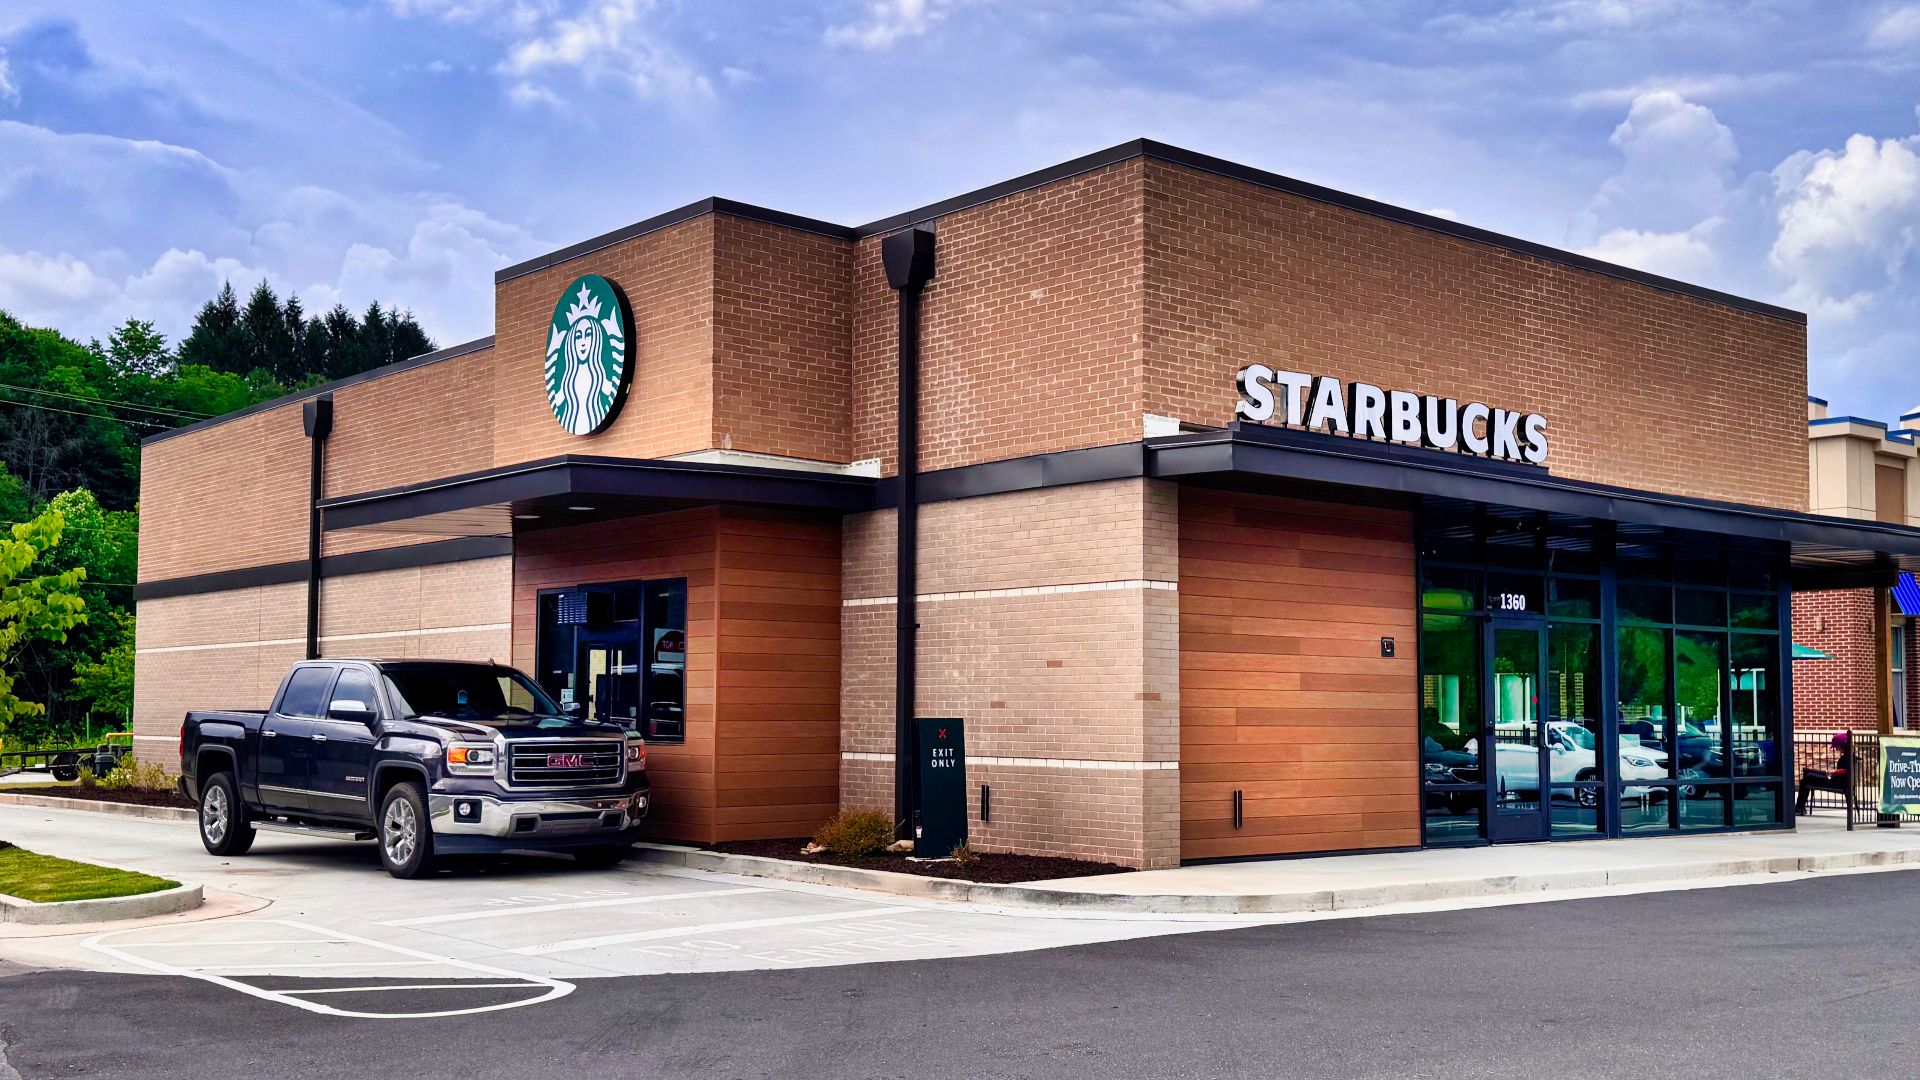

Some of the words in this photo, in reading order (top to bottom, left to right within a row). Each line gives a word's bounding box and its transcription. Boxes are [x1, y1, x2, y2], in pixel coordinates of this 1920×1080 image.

[1236, 363, 1548, 464] STARBUCKS
[1500, 592, 1526, 611] 1360
[546, 753, 595, 769] GMC
[932, 748, 954, 757] EXIT
[931, 759, 956, 768] ONLY
[1891, 775, 1906, 788] Now
[632, 939, 741, 958] DO
[799, 918, 929, 938] NOT
[742, 932, 973, 964] ENTER
